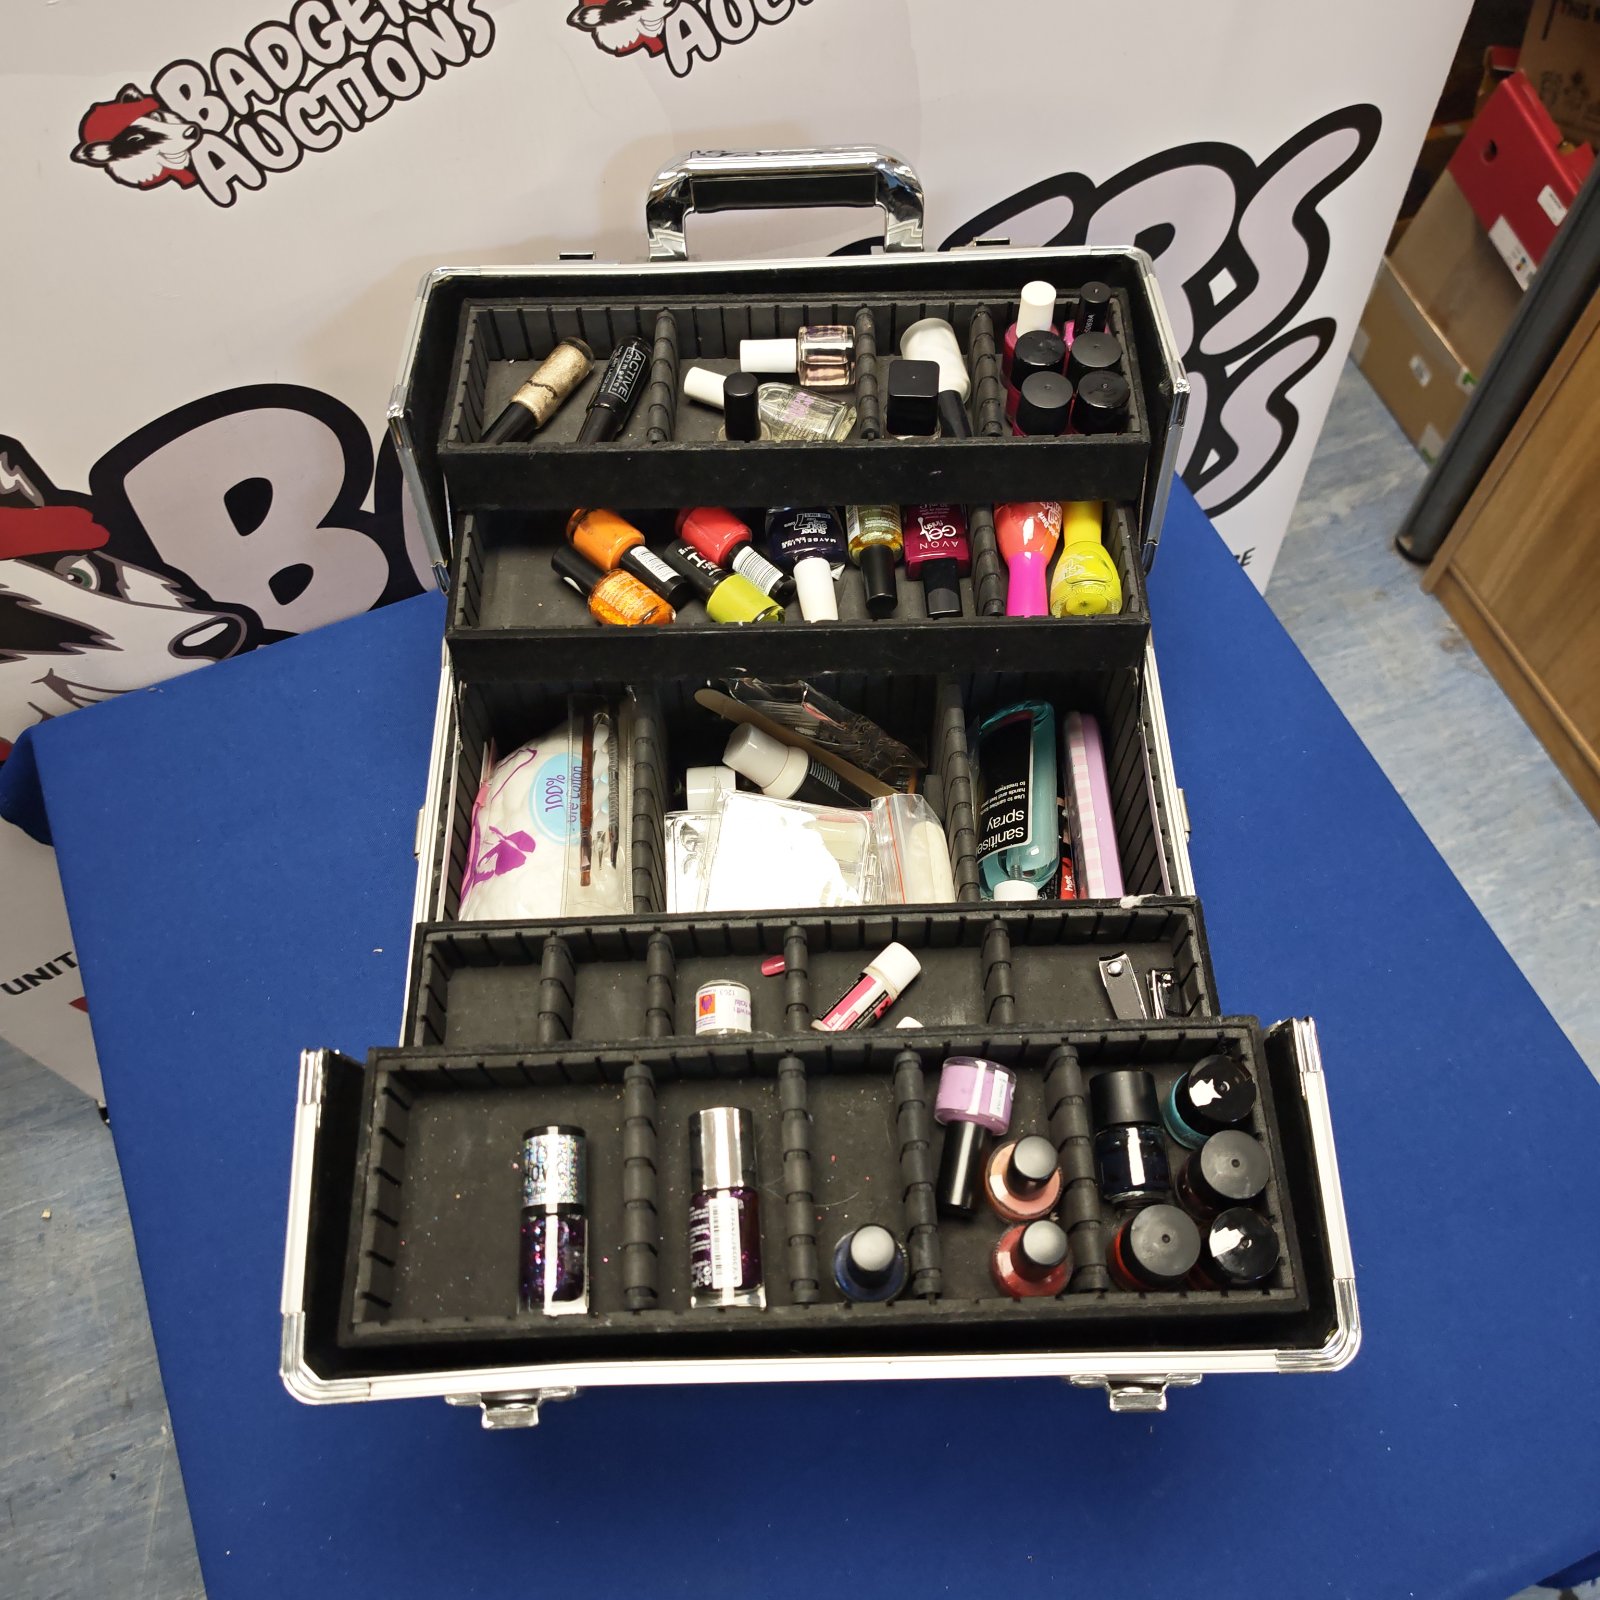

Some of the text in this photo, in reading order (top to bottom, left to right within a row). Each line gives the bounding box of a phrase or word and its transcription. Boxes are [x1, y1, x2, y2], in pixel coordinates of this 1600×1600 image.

[188, 0, 496, 208] AUCTIONS
[617, 351, 642, 398] ACTIVE
[919, 540, 959, 550] AVON
[545, 774, 565, 812] 100%
[1008, 787, 1026, 795] hands
[986, 808, 1025, 833] spray
[0, 951, 78, 995] UNIT
